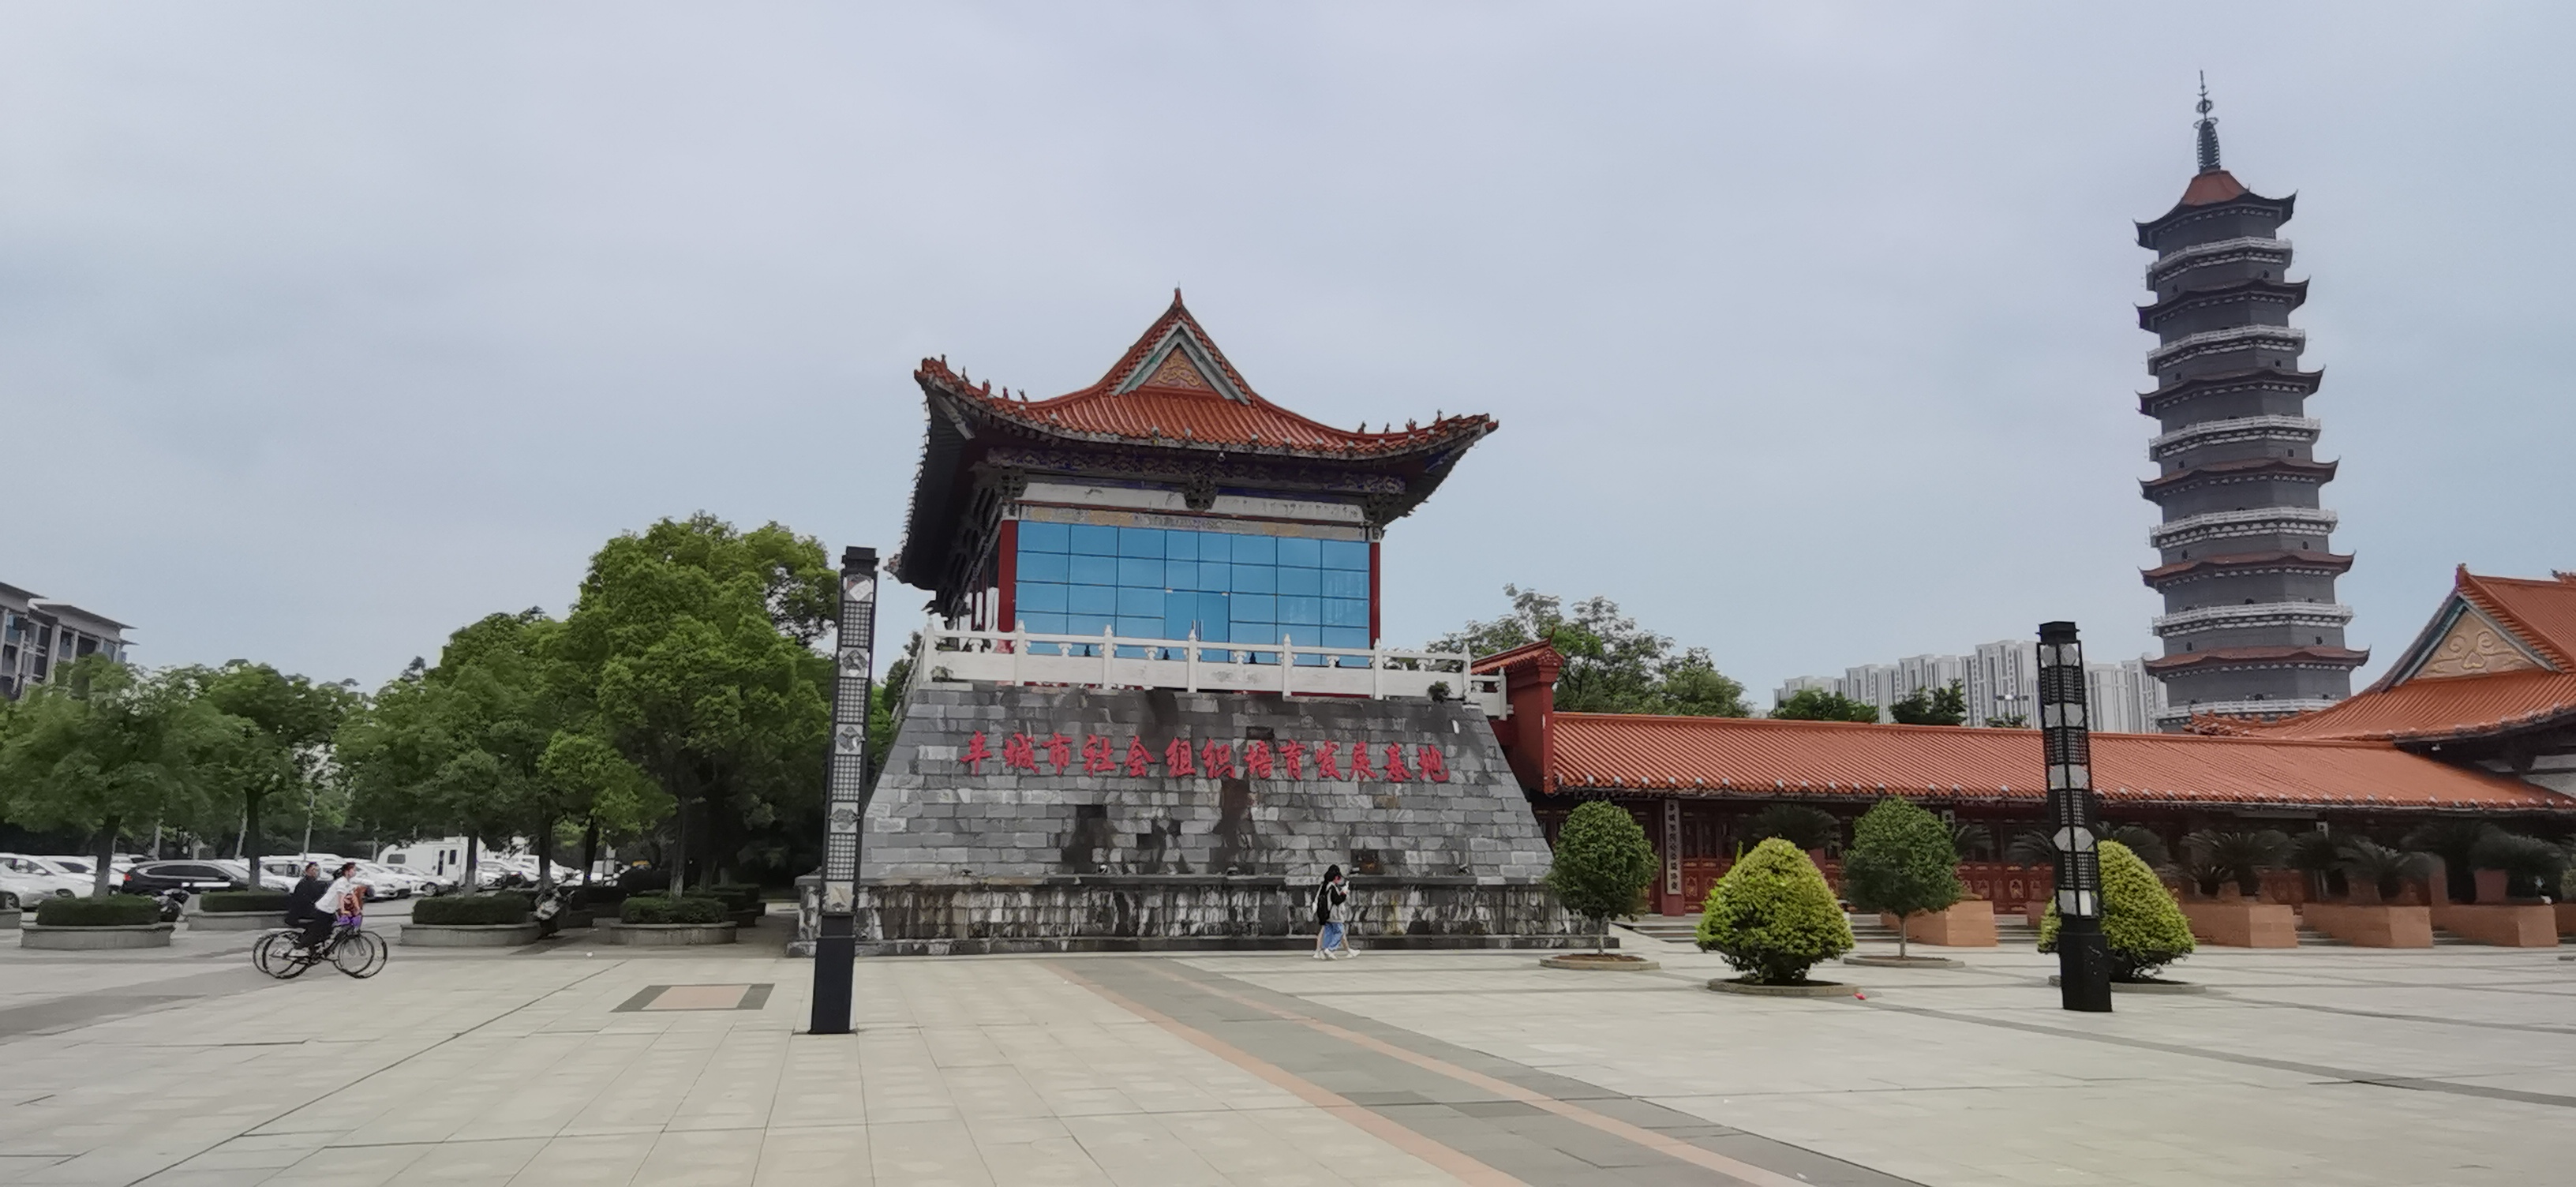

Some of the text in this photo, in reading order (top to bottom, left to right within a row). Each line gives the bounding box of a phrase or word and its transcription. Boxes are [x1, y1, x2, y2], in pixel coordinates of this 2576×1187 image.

[960, 730, 1449, 782] 丰城市社会组织培育发展基地
